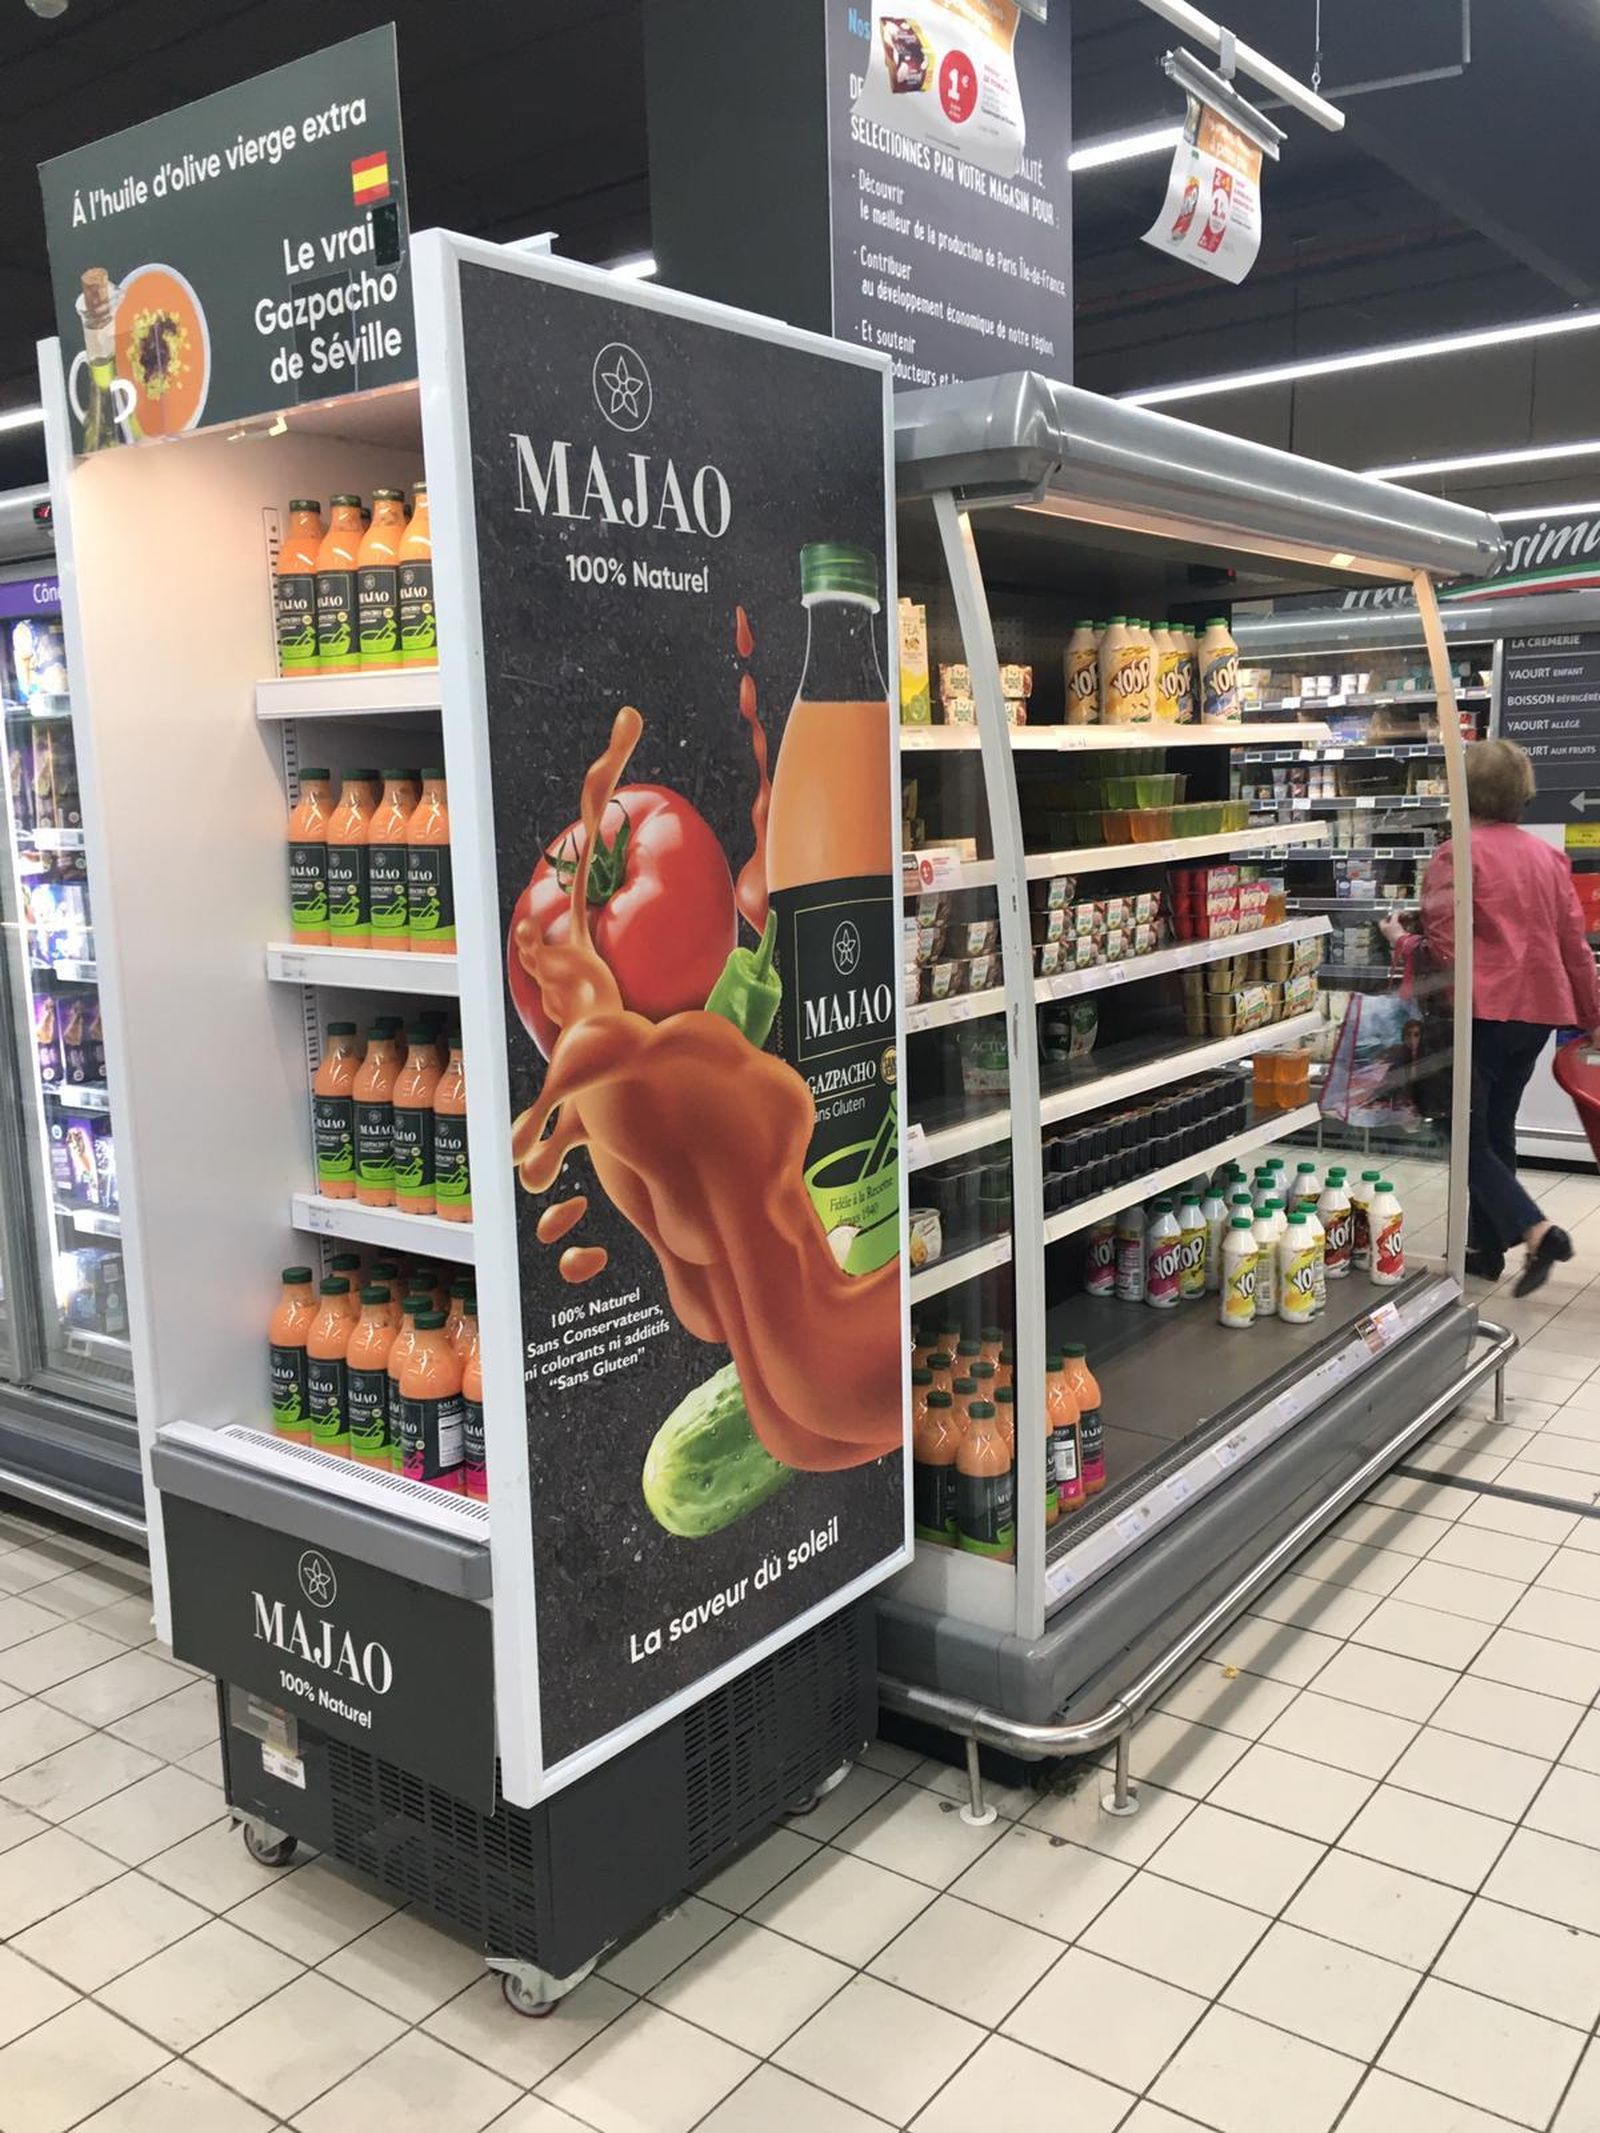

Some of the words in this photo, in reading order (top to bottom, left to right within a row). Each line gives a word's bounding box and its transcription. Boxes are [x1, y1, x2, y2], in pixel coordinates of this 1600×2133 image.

[848, 8, 870, 40] Nos
[72, 190, 87, 228] Á
[89, 175, 148, 221] l'huile
[153, 154, 221, 198] d'olive
[225, 125, 296, 171] vierge
[302, 98, 367, 142] extra
[858, 168, 905, 205] Découvrir
[933, 151, 954, 181] PAR
[957, 161, 987, 195] VOTRE
[989, 176, 1030, 215] MAGASIN
[1032, 197, 1054, 226] POUR
[283, 239, 315, 275] Le
[320, 211, 375, 263] vrai
[859, 197, 869, 221] le
[872, 206, 911, 235] meilleur
[914, 220, 925, 241] de
[927, 224, 936, 245] la
[938, 231, 983, 263] production
[985, 248, 995, 267] de
[997, 251, 1017, 276] Paris
[860, 245, 912, 281] Contribuer
[255, 270, 397, 335] Gazpacho
[861, 278, 874, 296] au
[876, 280, 944, 319] développement
[946, 303, 995, 337] économique
[996, 319, 1006, 340] de
[1008, 327, 1029, 346] notre
[270, 347, 304, 384] de
[310, 320, 402, 374] Séville
[861, 319, 873, 342] Et
[876, 328, 916, 354] soutenir
[509, 433, 732, 539] MAJAO
[565, 554, 627, 586] 100%
[633, 560, 710, 594] Naturel
[1507, 693, 1555, 707] BOISSON
[1508, 667, 1551, 680] YAOURT
[1552, 667, 1584, 677] ENFANT
[1507, 719, 1550, 732] YAOURT
[1550, 745, 1567, 755] AUX
[1568, 745, 1597, 755] FRUITS
[804, 983, 892, 1040] MAJAO
[807, 1060, 877, 1095] GAZPACHO
[832, 1096, 866, 1117] Gluten
[527, 1337, 560, 1358] Sans
[563, 1304, 664, 1345] Conservateurs,
[551, 1304, 586, 1329] 100%
[588, 1286, 640, 1317] Naturel
[524, 1364, 537, 1382] ni
[541, 1343, 605, 1375] colorants
[608, 1334, 621, 1351] ni
[624, 1318, 670, 1346] additifs
[630, 1627, 661, 1664] La
[669, 1577, 749, 1642] saveur
[787, 1515, 839, 1570] soleil
[251, 1590, 393, 1695] MAJAO
[279, 1669, 315, 1702] 100%
[318, 1688, 372, 1729] Naturel
